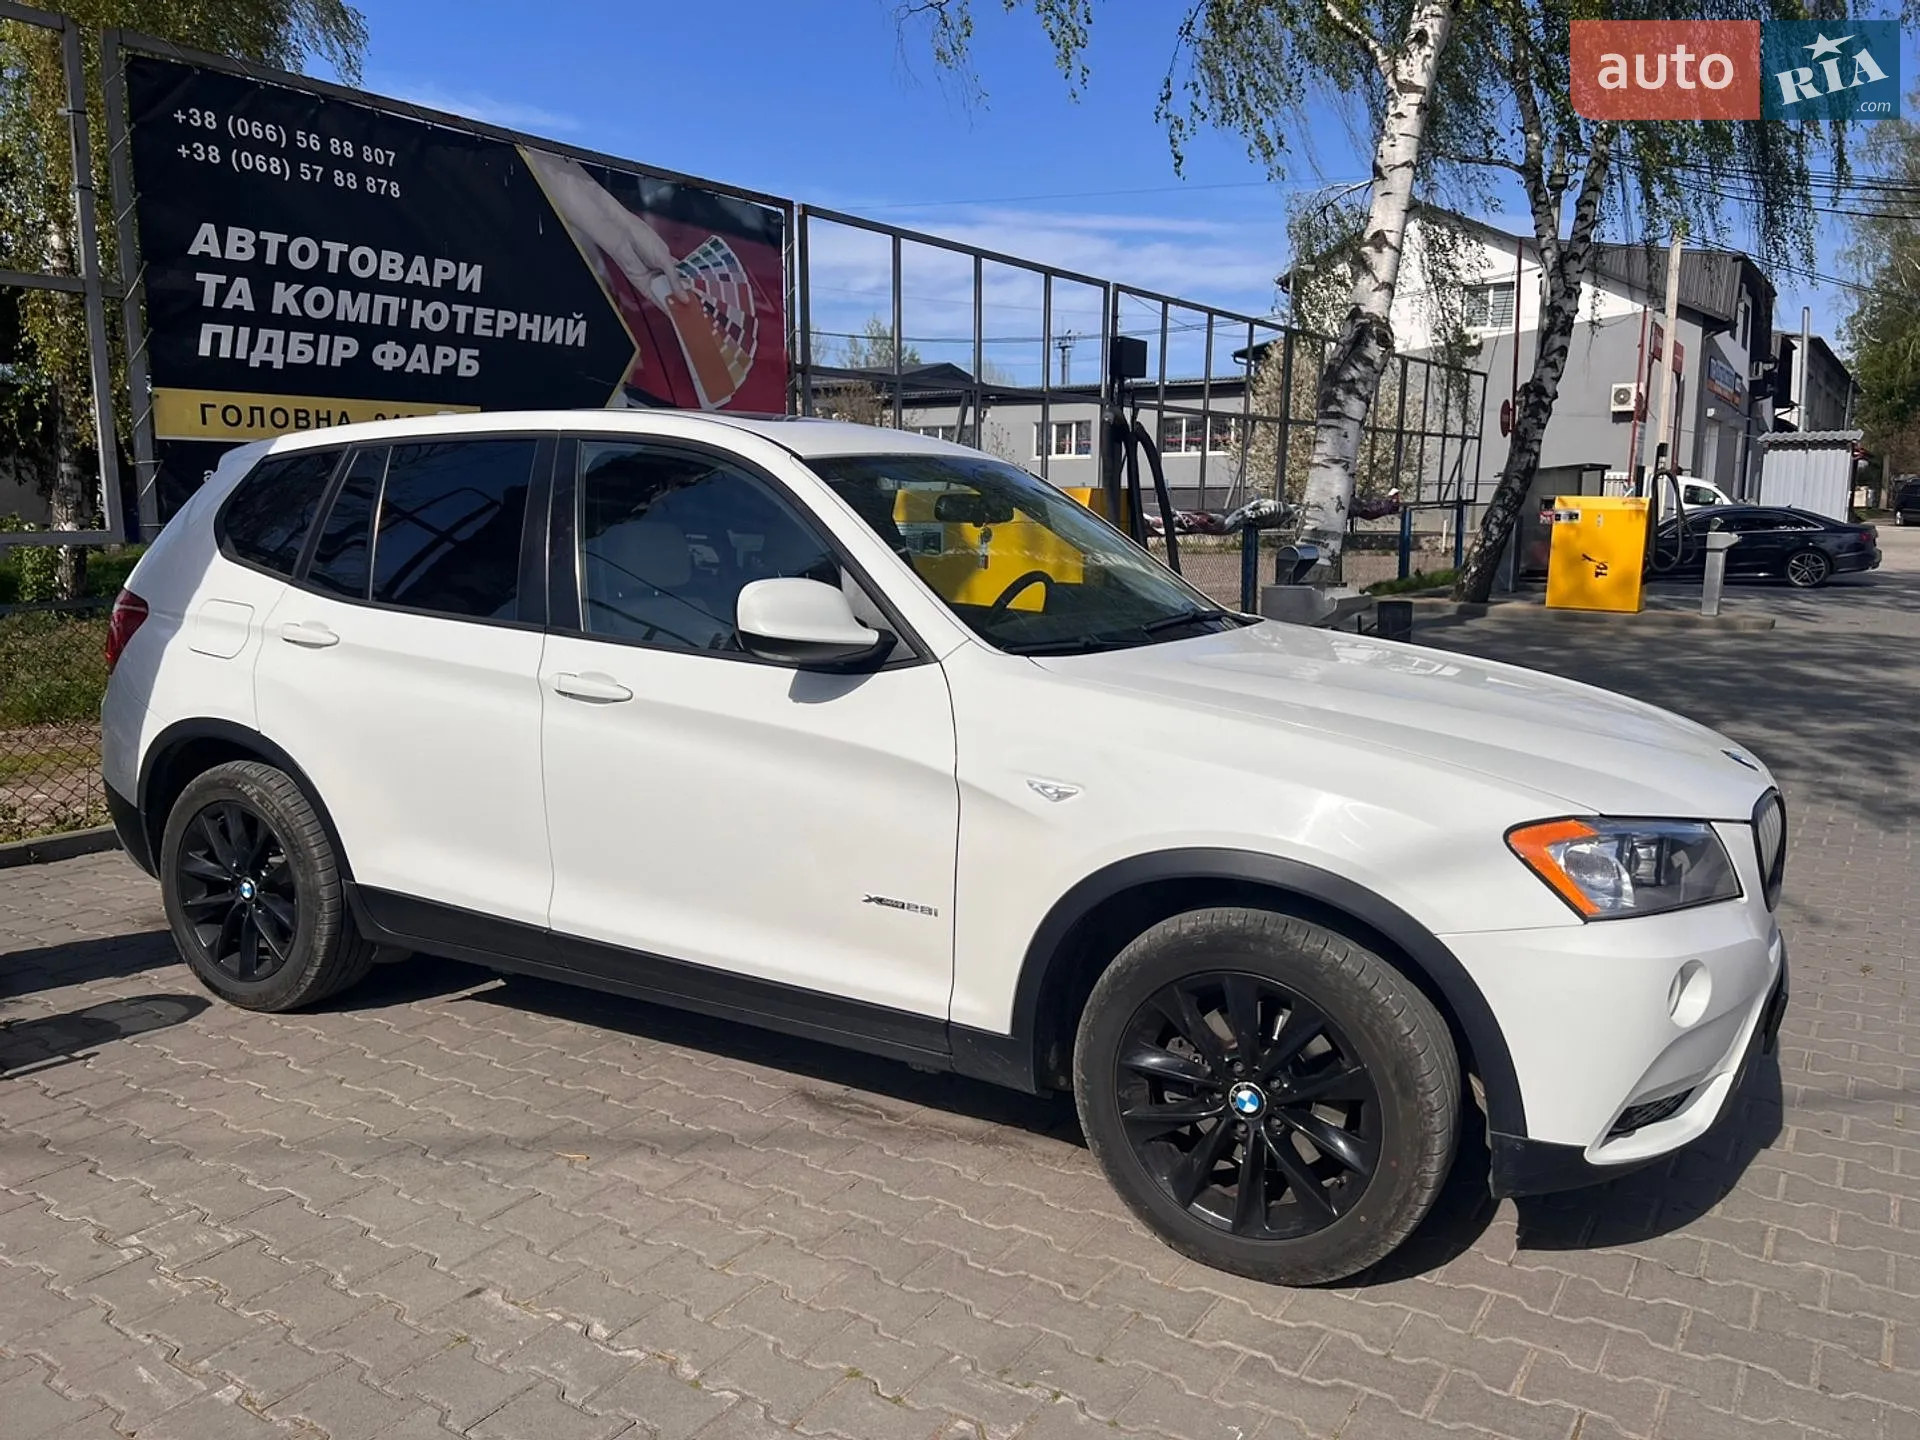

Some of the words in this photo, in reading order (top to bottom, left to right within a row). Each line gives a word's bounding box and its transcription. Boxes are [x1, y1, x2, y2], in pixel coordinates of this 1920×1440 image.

[173, 107, 217, 130] +38
[227, 115, 287, 148] (066)
[296, 130, 321, 151] 56
[329, 137, 354, 158] 88
[362, 145, 396, 167] 807
[177, 142, 221, 164] +38
[231, 148, 290, 181] (068)
[299, 162, 324, 183] 57
[333, 169, 358, 190] 88
[365, 176, 401, 198] 878
[187, 222, 483, 293] АВТОТОВАРИ
[195, 272, 255, 312] ТА
[271, 281, 587, 347] КОМП'ЮТЕРНИЙ
[197, 323, 359, 370] ПІДБІР
[372, 340, 480, 377] ФАРБ
